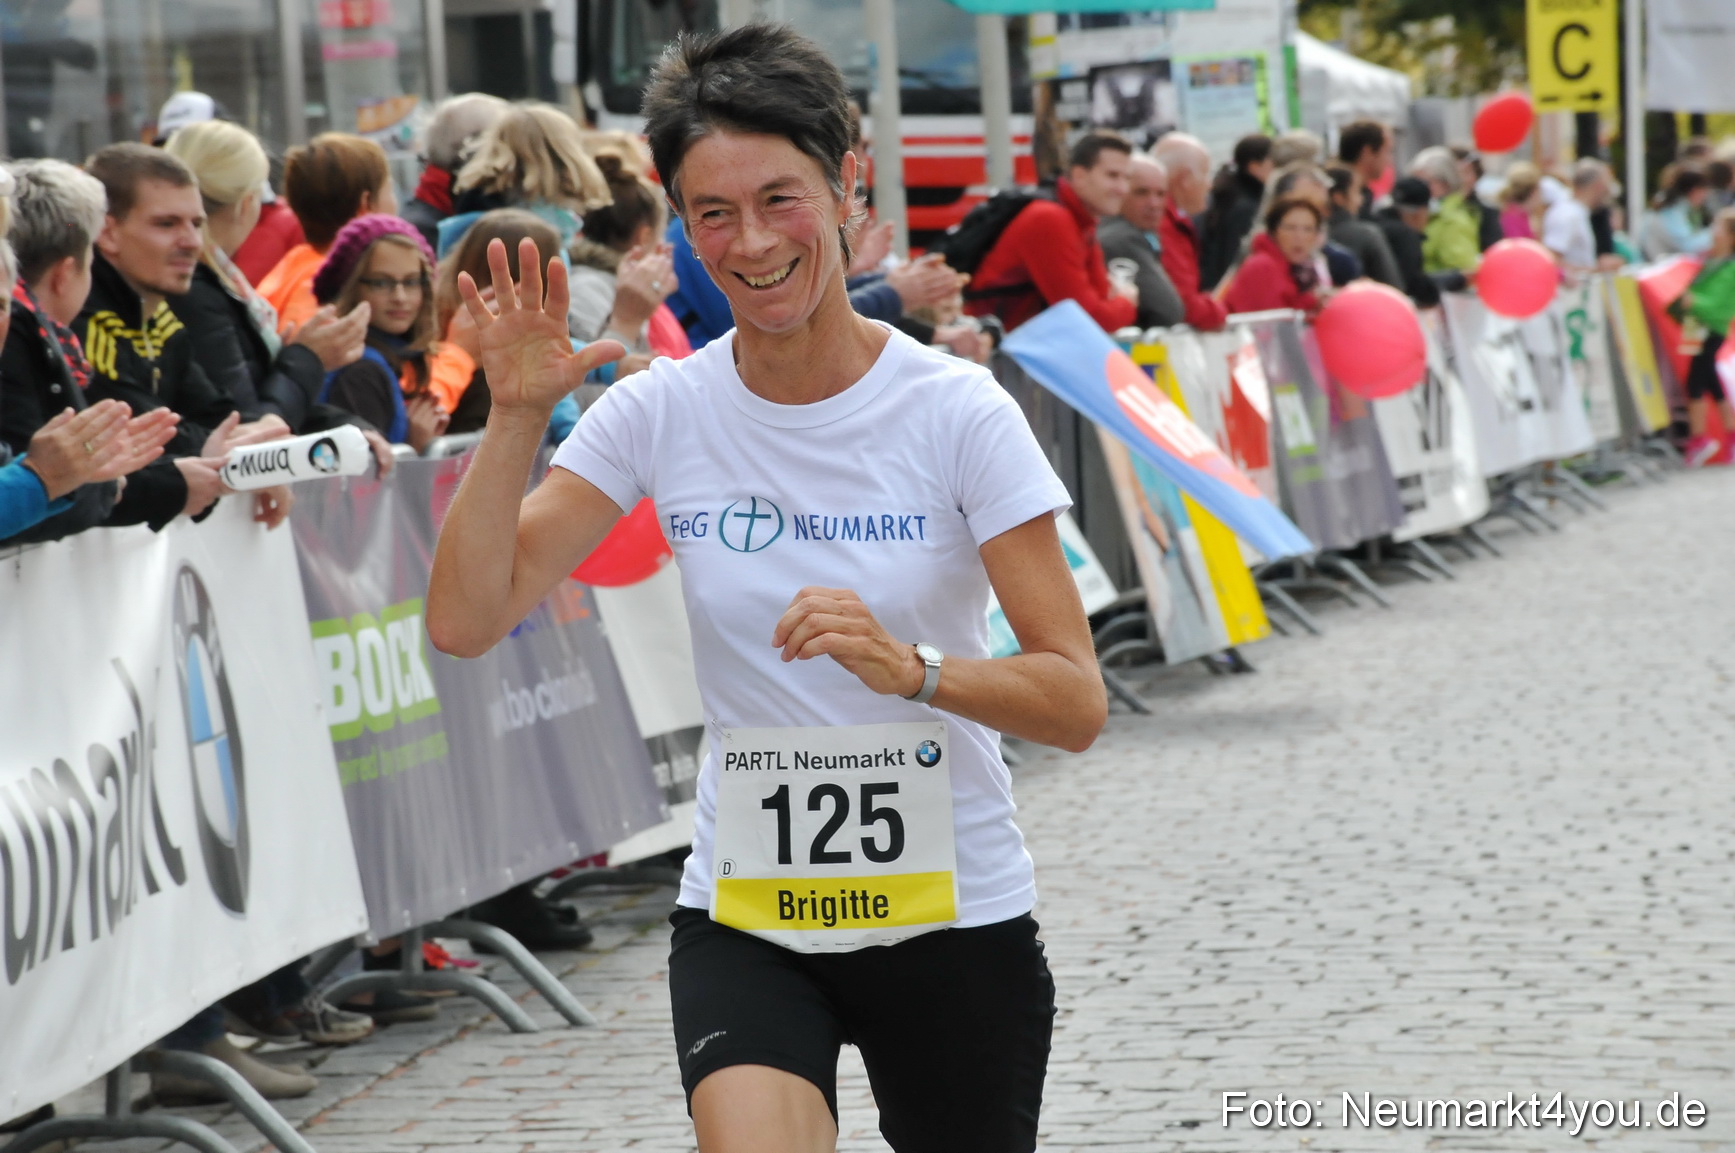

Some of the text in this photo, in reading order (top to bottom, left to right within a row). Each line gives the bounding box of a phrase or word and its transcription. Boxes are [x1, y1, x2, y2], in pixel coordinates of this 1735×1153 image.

[1553, 22, 1591, 81] C
[670, 512, 926, 541] FeG NEUMARKT
[313, 613, 437, 727] BOCK
[725, 750, 788, 771] PARTL
[794, 747, 906, 770] Neumarkt
[761, 781, 905, 865] 125
[722, 861, 731, 875] D
[778, 888, 889, 928] Brigitte
